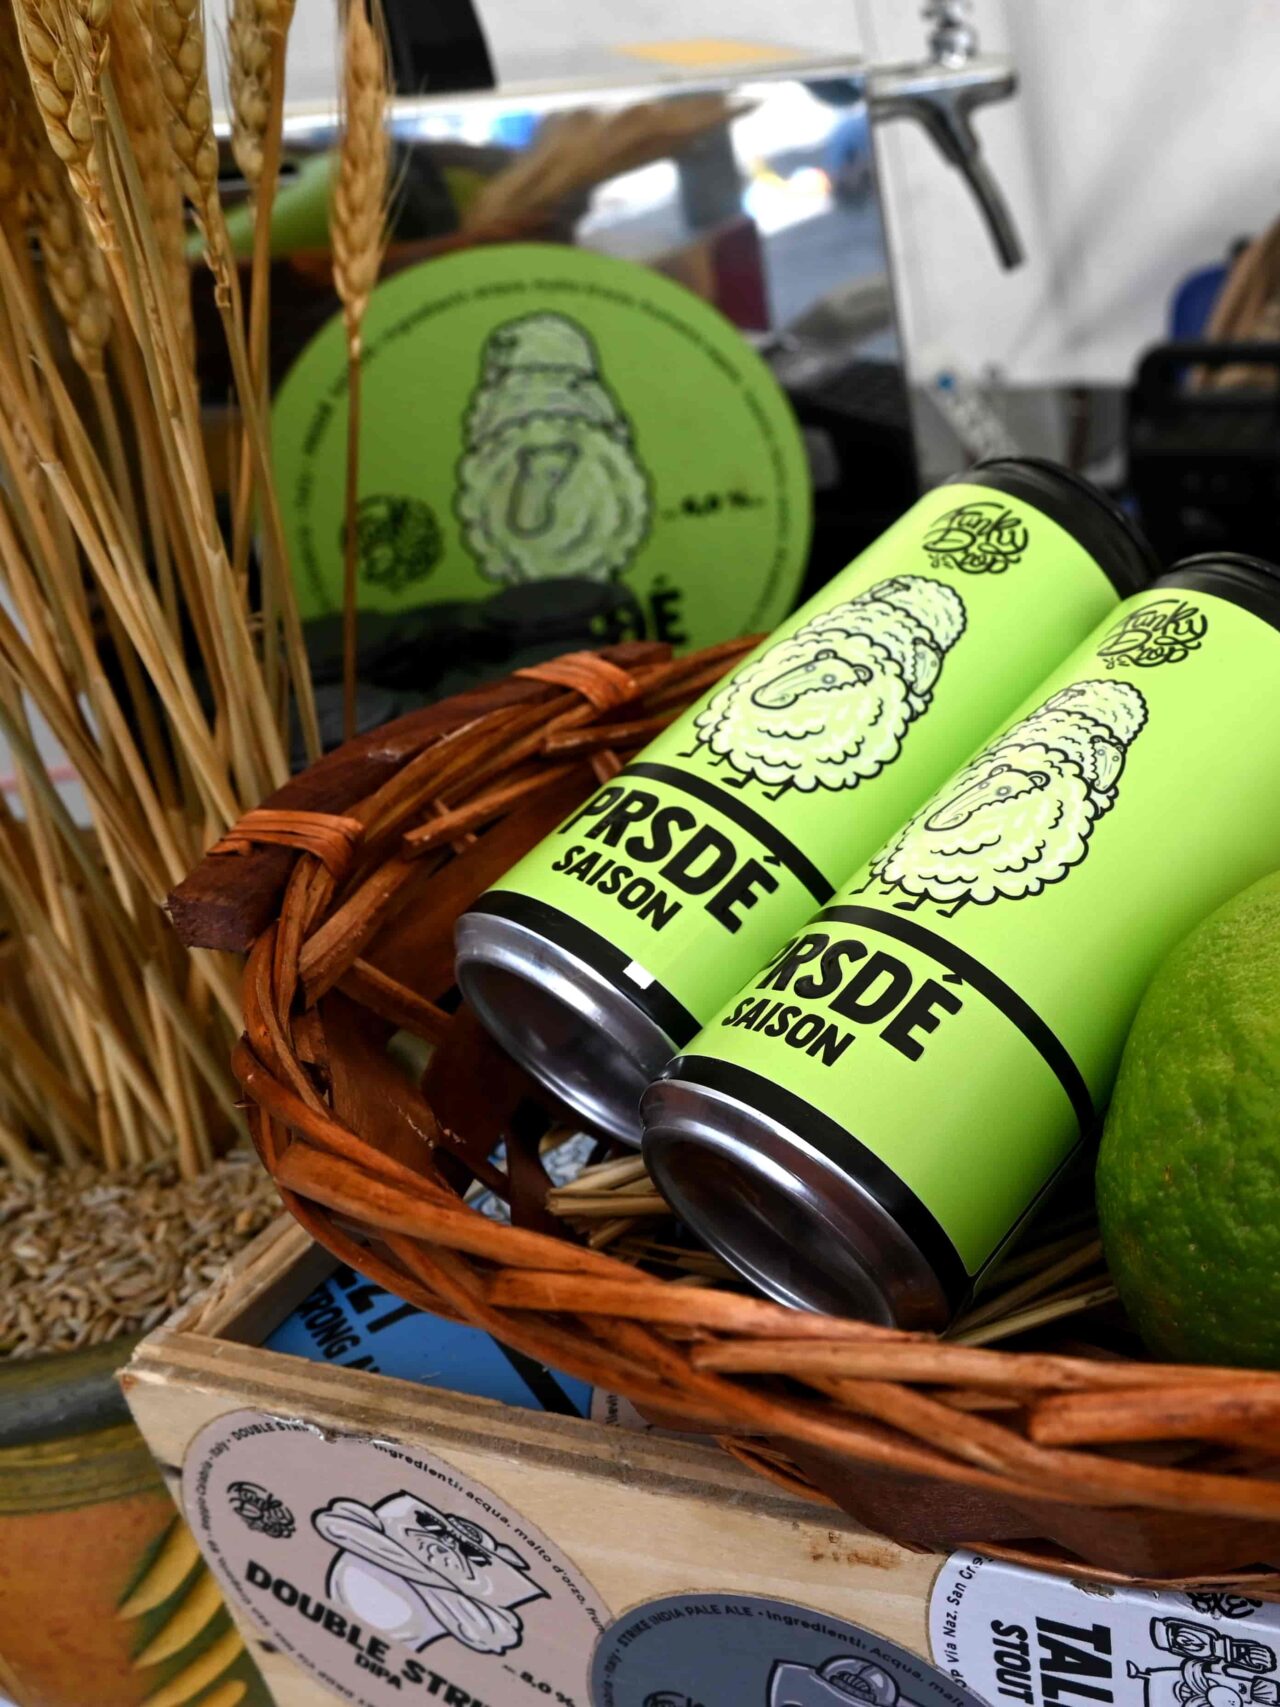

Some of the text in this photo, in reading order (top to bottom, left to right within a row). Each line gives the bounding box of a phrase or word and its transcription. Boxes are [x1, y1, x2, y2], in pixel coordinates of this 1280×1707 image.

[551, 845, 683, 932] SAISON
[557, 786, 780, 935] PRSDÉ
[721, 997, 856, 1067] SAISON
[231, 1422, 276, 1440] DOUBLE
[465, 1490, 511, 1528] acqua,
[514, 1527, 552, 1563] malto
[552, 1563, 586, 1606] d'orzo,
[245, 1559, 391, 1664] DOUBLE
[943, 1609, 959, 1638] Naz.
[946, 1581, 968, 1607] San
[355, 1652, 403, 1691] DIPA
[616, 1619, 653, 1648] STRIKE
[648, 1607, 685, 1626] INDIA
[684, 1603, 722, 1617] PALE
[724, 1604, 754, 1617] ALE
[766, 1609, 867, 1650] Ingredienti:
[869, 1647, 925, 1683] Acqua,
[990, 1619, 1035, 1706] STOUT
[1034, 1615, 1115, 1707] TAL
